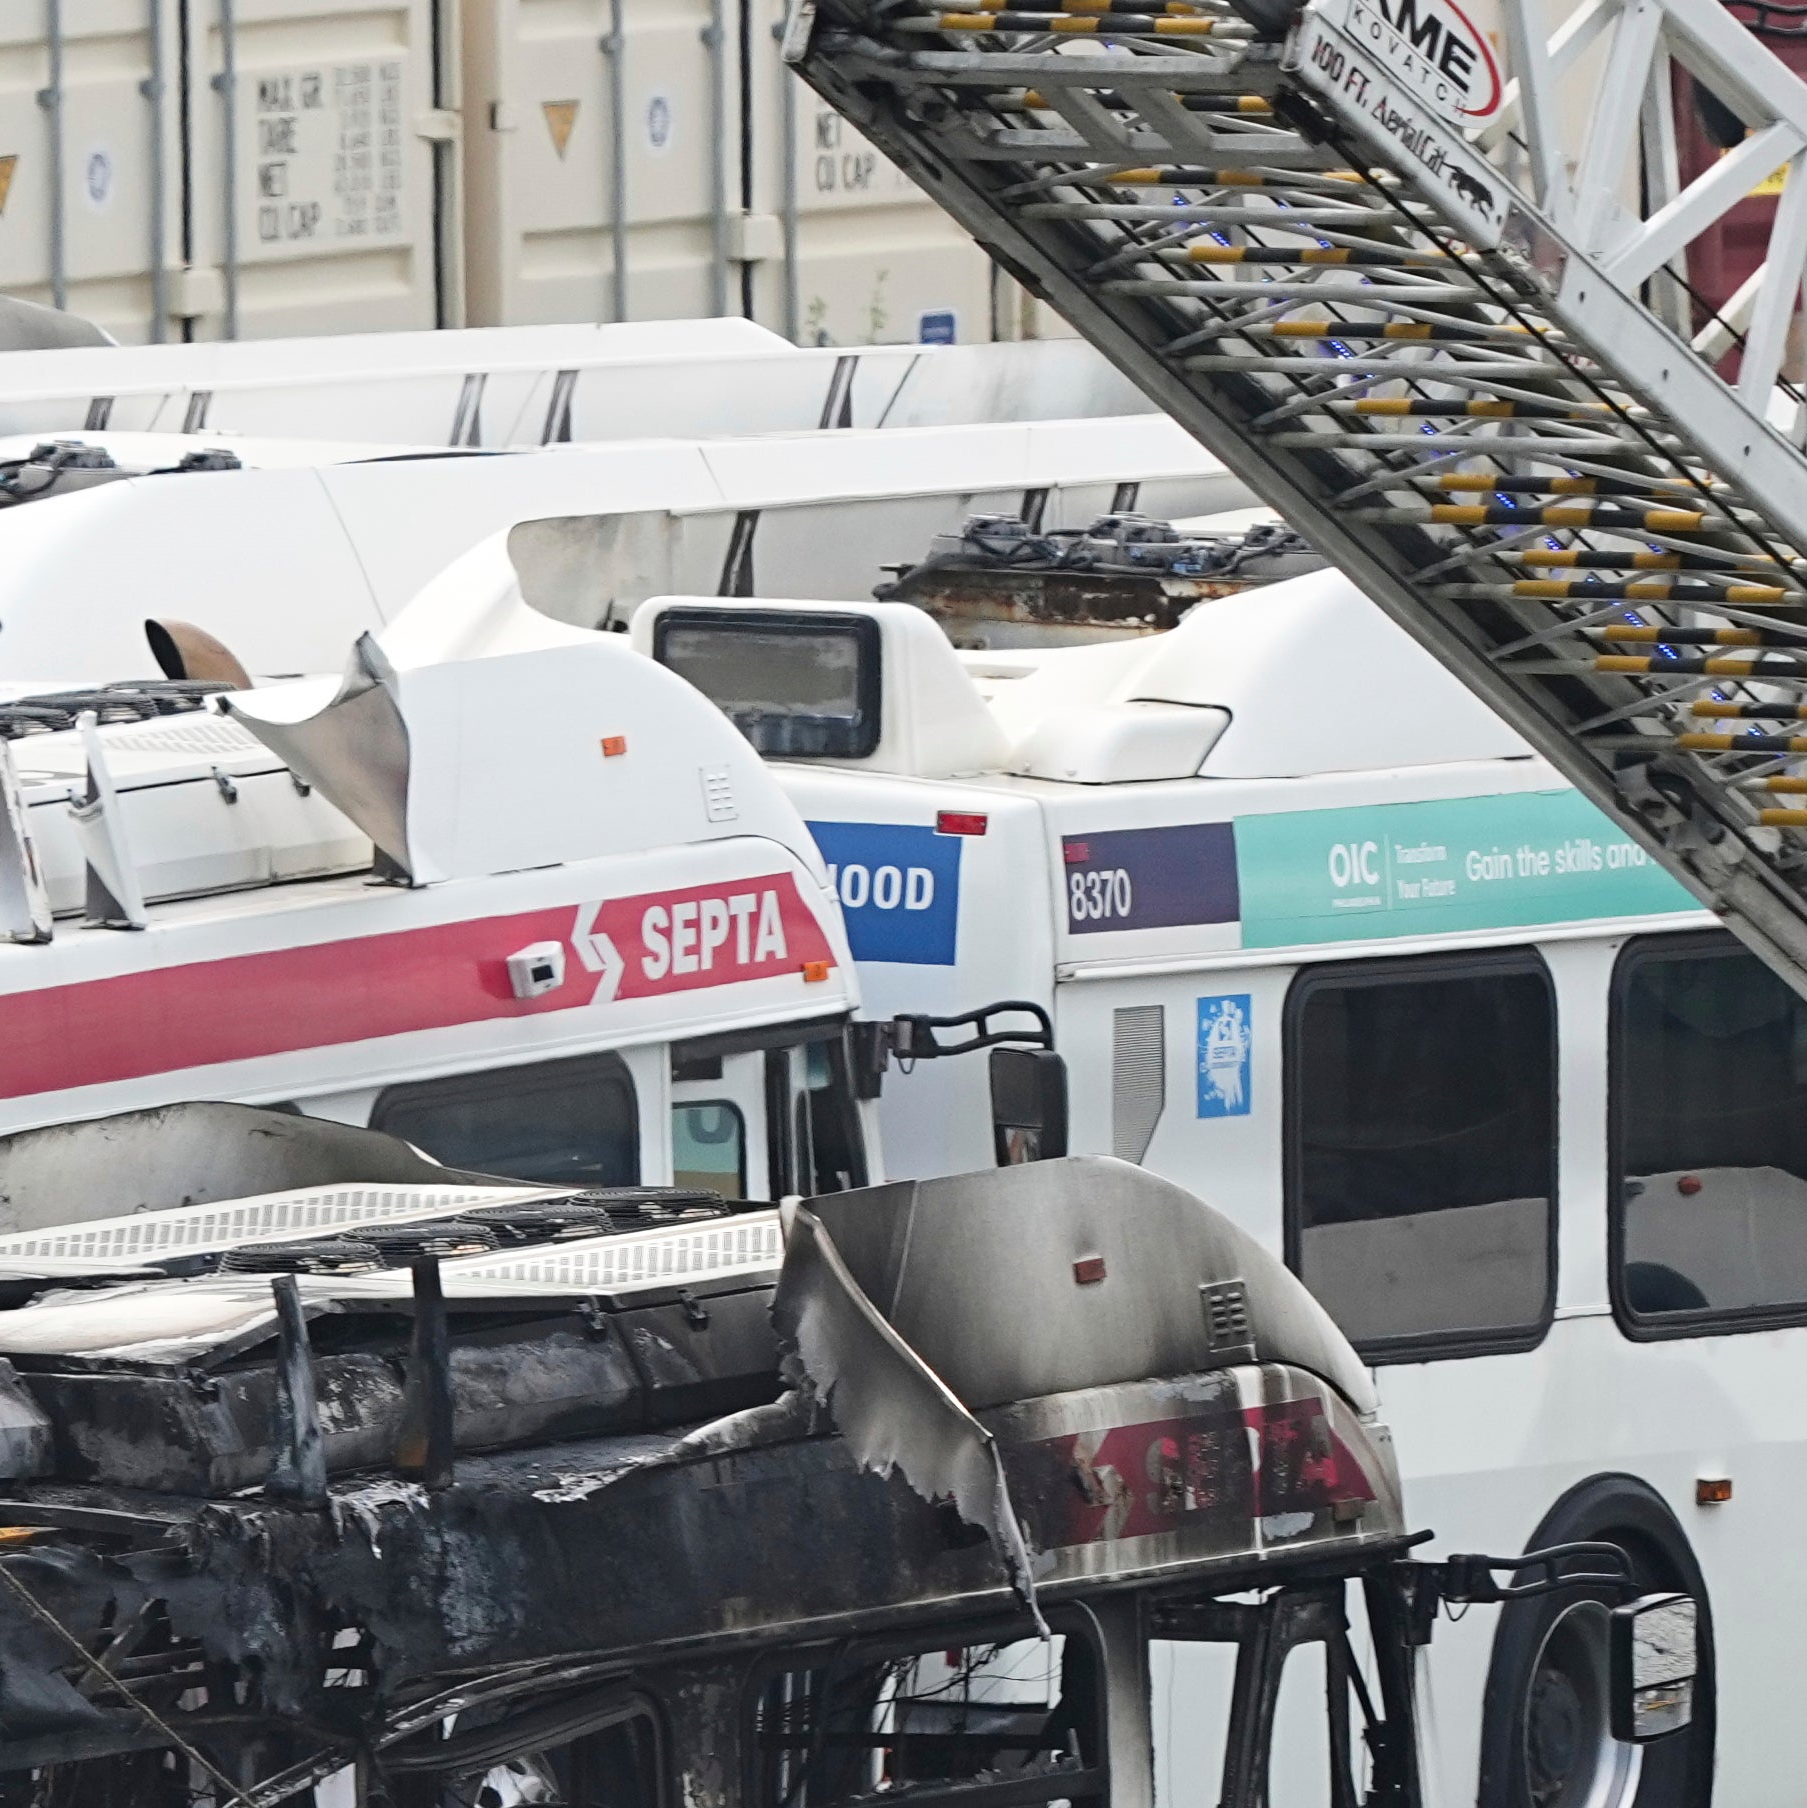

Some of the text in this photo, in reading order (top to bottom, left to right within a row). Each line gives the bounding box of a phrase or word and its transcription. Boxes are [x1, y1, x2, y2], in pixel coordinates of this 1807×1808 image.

[1311, 34, 1345, 82] 100
[1354, 6, 1468, 119] KOVATCH
[1379, 0, 1478, 94] ME
[1329, 840, 1381, 888] OIC
[1465, 846, 1514, 882] Gain
[1515, 844, 1550, 877] the
[1553, 838, 1603, 874] skills
[828, 864, 935, 910] OOD
[1070, 868, 1132, 921] 8370
[1421, 877, 1457, 898] Future
[641, 889, 788, 981] SEPTA
